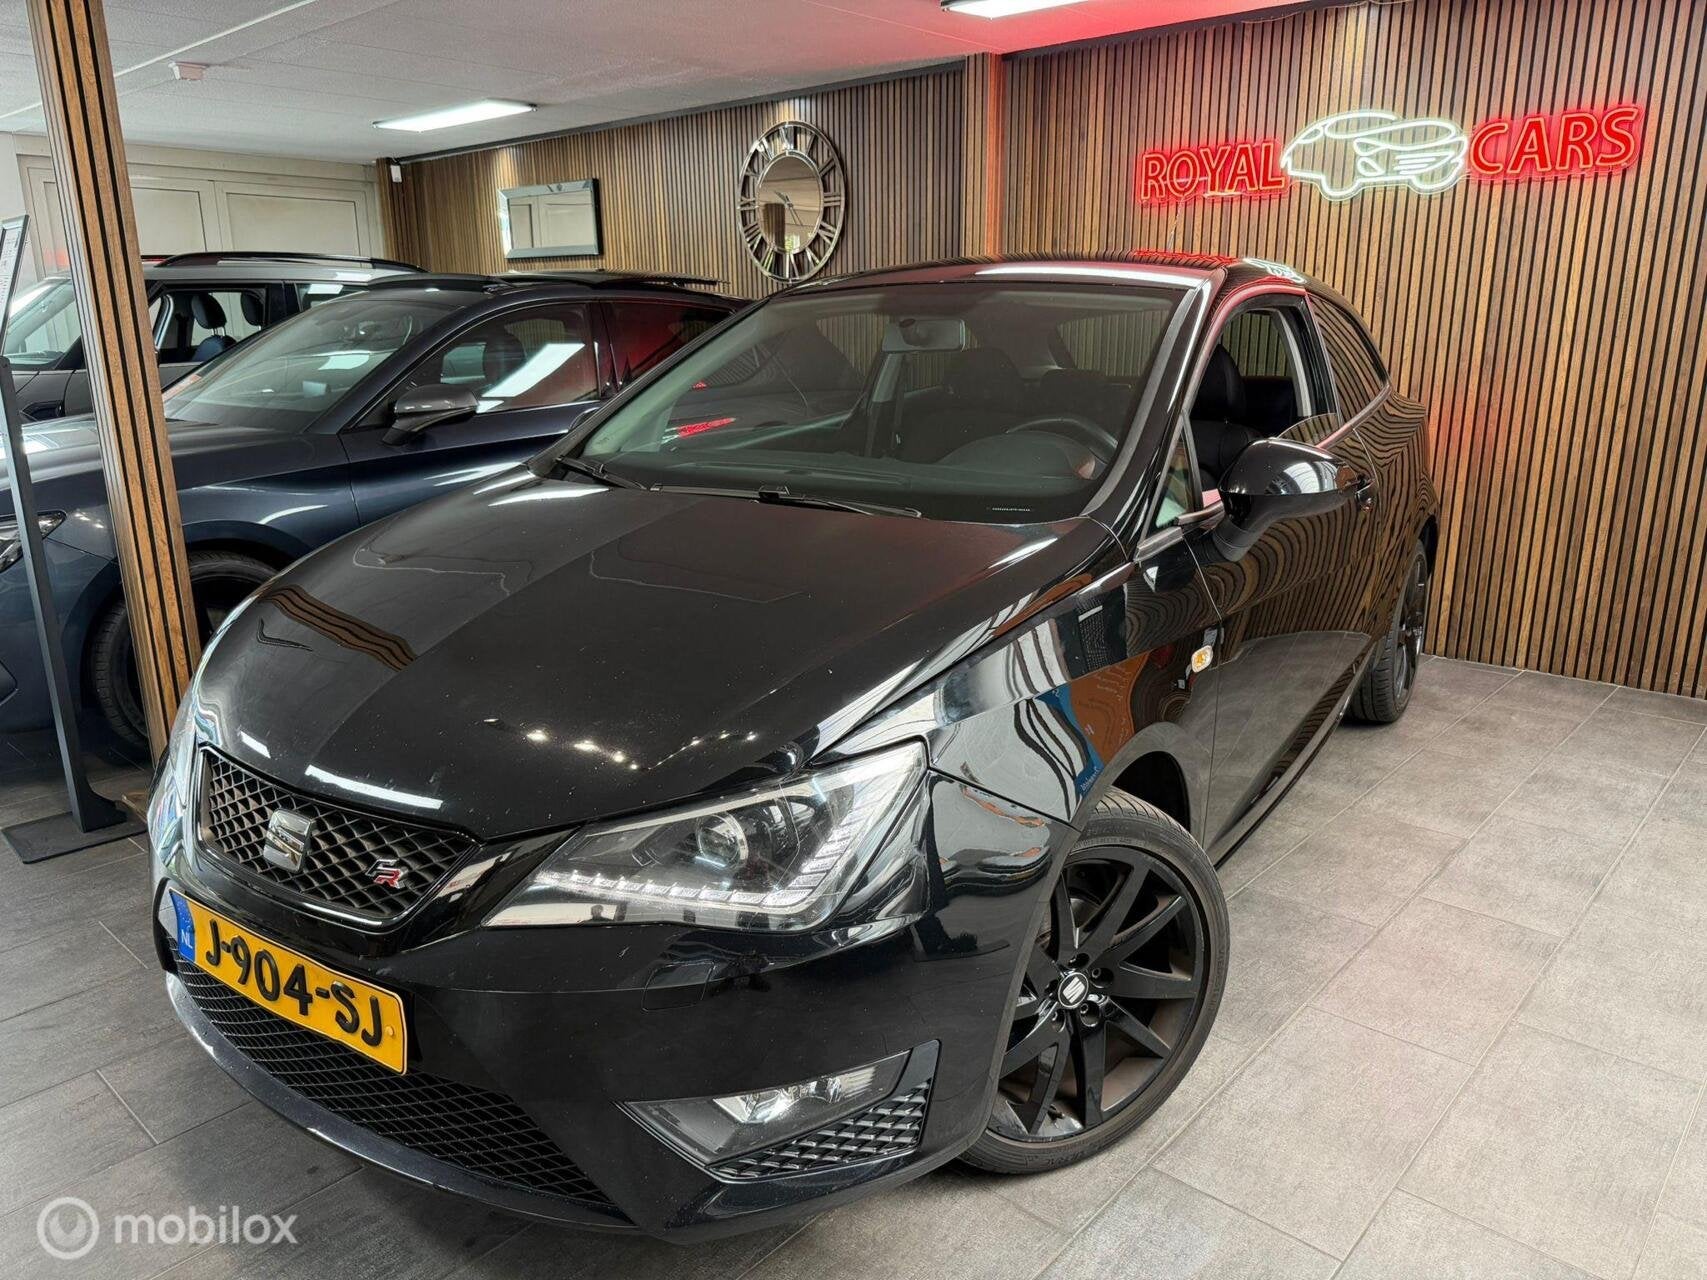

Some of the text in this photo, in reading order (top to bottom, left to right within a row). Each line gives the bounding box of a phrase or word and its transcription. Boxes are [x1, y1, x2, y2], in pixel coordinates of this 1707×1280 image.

[1140, 106, 1641, 200] ROYAL CARS
[180, 929, 194, 950] NL
[205, 919, 383, 1047] J-904-SJ
